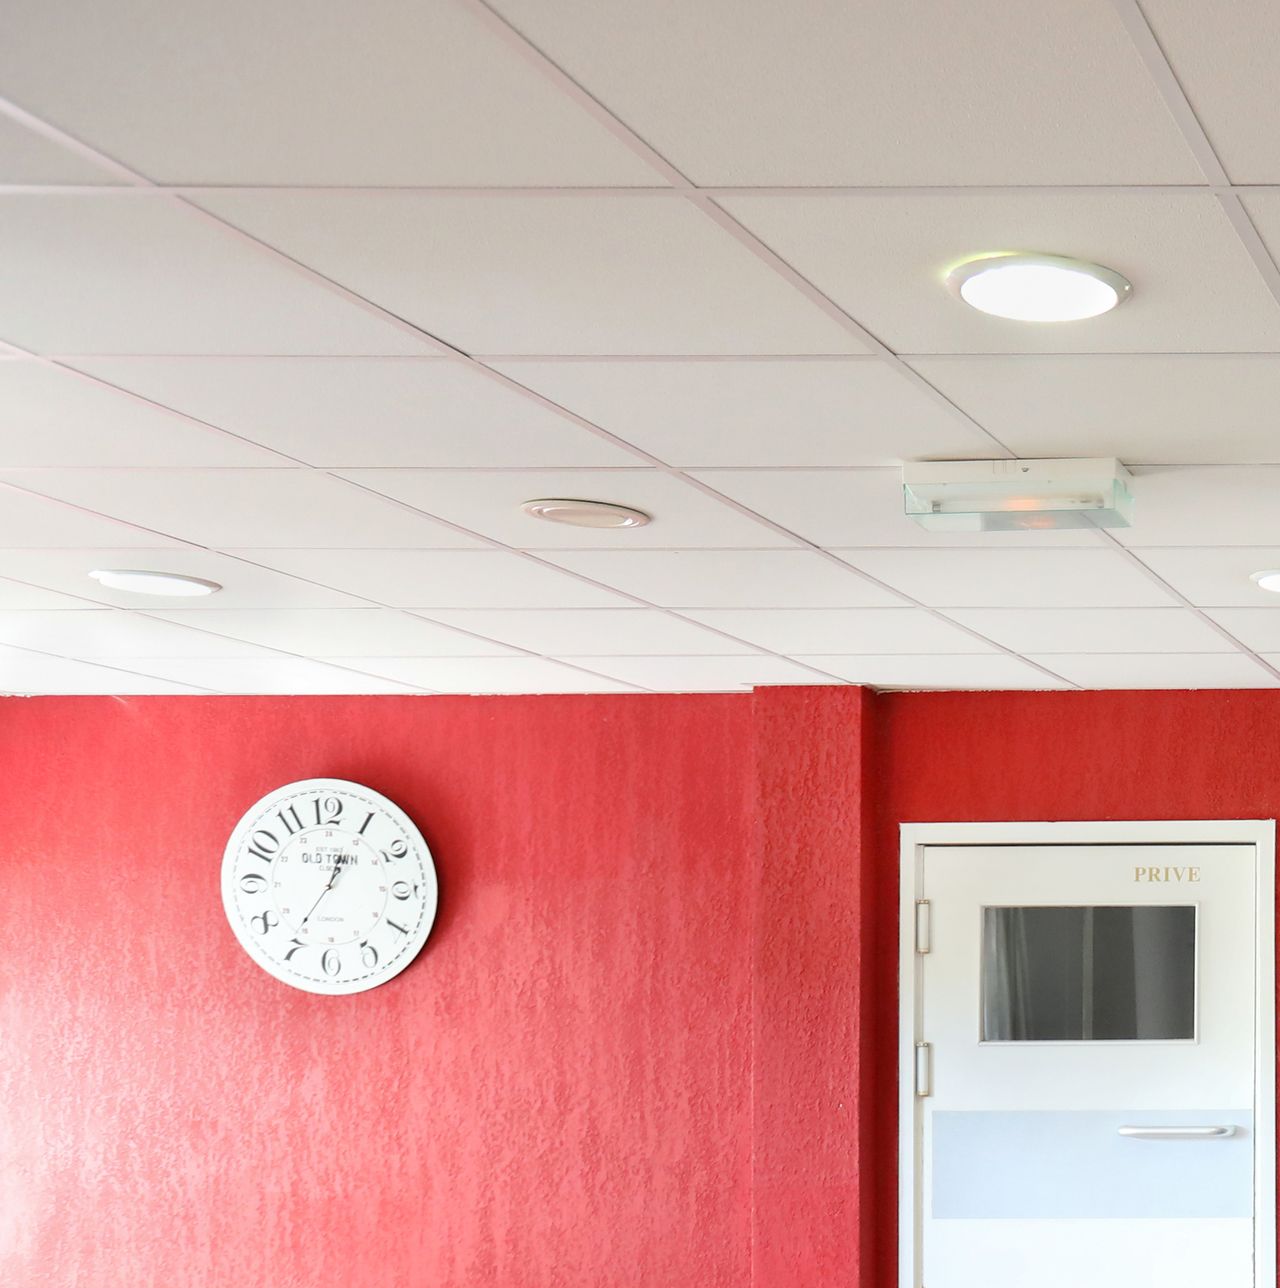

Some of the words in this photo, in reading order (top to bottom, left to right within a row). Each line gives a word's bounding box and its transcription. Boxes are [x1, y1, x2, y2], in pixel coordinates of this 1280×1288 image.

[275, 804, 307, 836] 11
[312, 796, 343, 826] 12
[358, 811, 376, 835] 1
[247, 829, 280, 864] 10
[302, 852, 322, 864] OLD
[326, 853, 359, 865] TOWN
[379, 839, 408, 863] 2
[239, 873, 267, 894] 9
[1134, 866, 1201, 882] PRIVE
[392, 879, 419, 901] 3
[250, 910, 279, 935] 8
[386, 917, 410, 945] 4
[283, 937, 310, 961] 7
[359, 939, 379, 969] 5
[321, 948, 342, 977] 6
